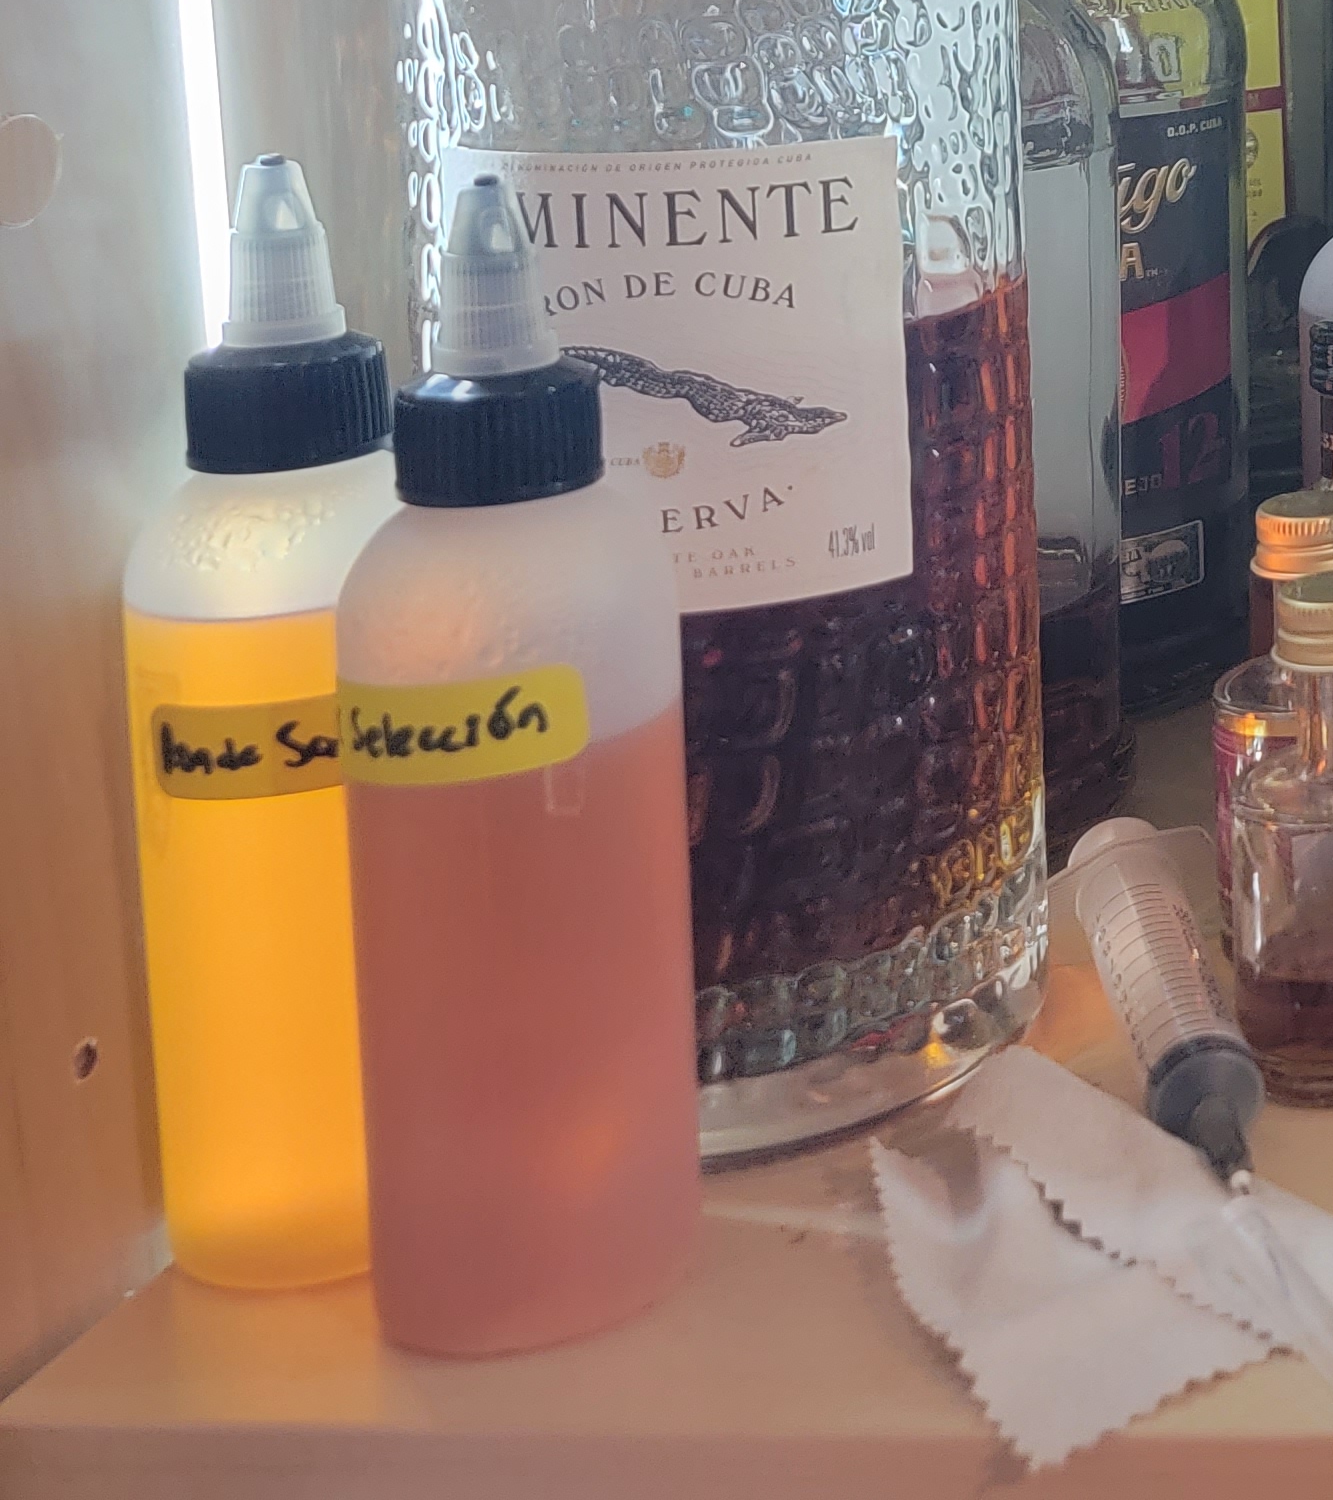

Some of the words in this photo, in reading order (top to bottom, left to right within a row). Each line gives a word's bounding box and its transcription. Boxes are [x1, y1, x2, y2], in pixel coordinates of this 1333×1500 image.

[690, 156, 770, 171] PROTEGIDA
[777, 152, 812, 165] CUBA
[514, 175, 859, 249] MINENTE
[623, 271, 677, 300] DE
[694, 271, 797, 310] CUBA
[661, 486, 785, 534] ERVA
[827, 525, 860, 560] 41.3%
[861, 522, 877, 553] vol
[692, 556, 797, 579] BARRELS
